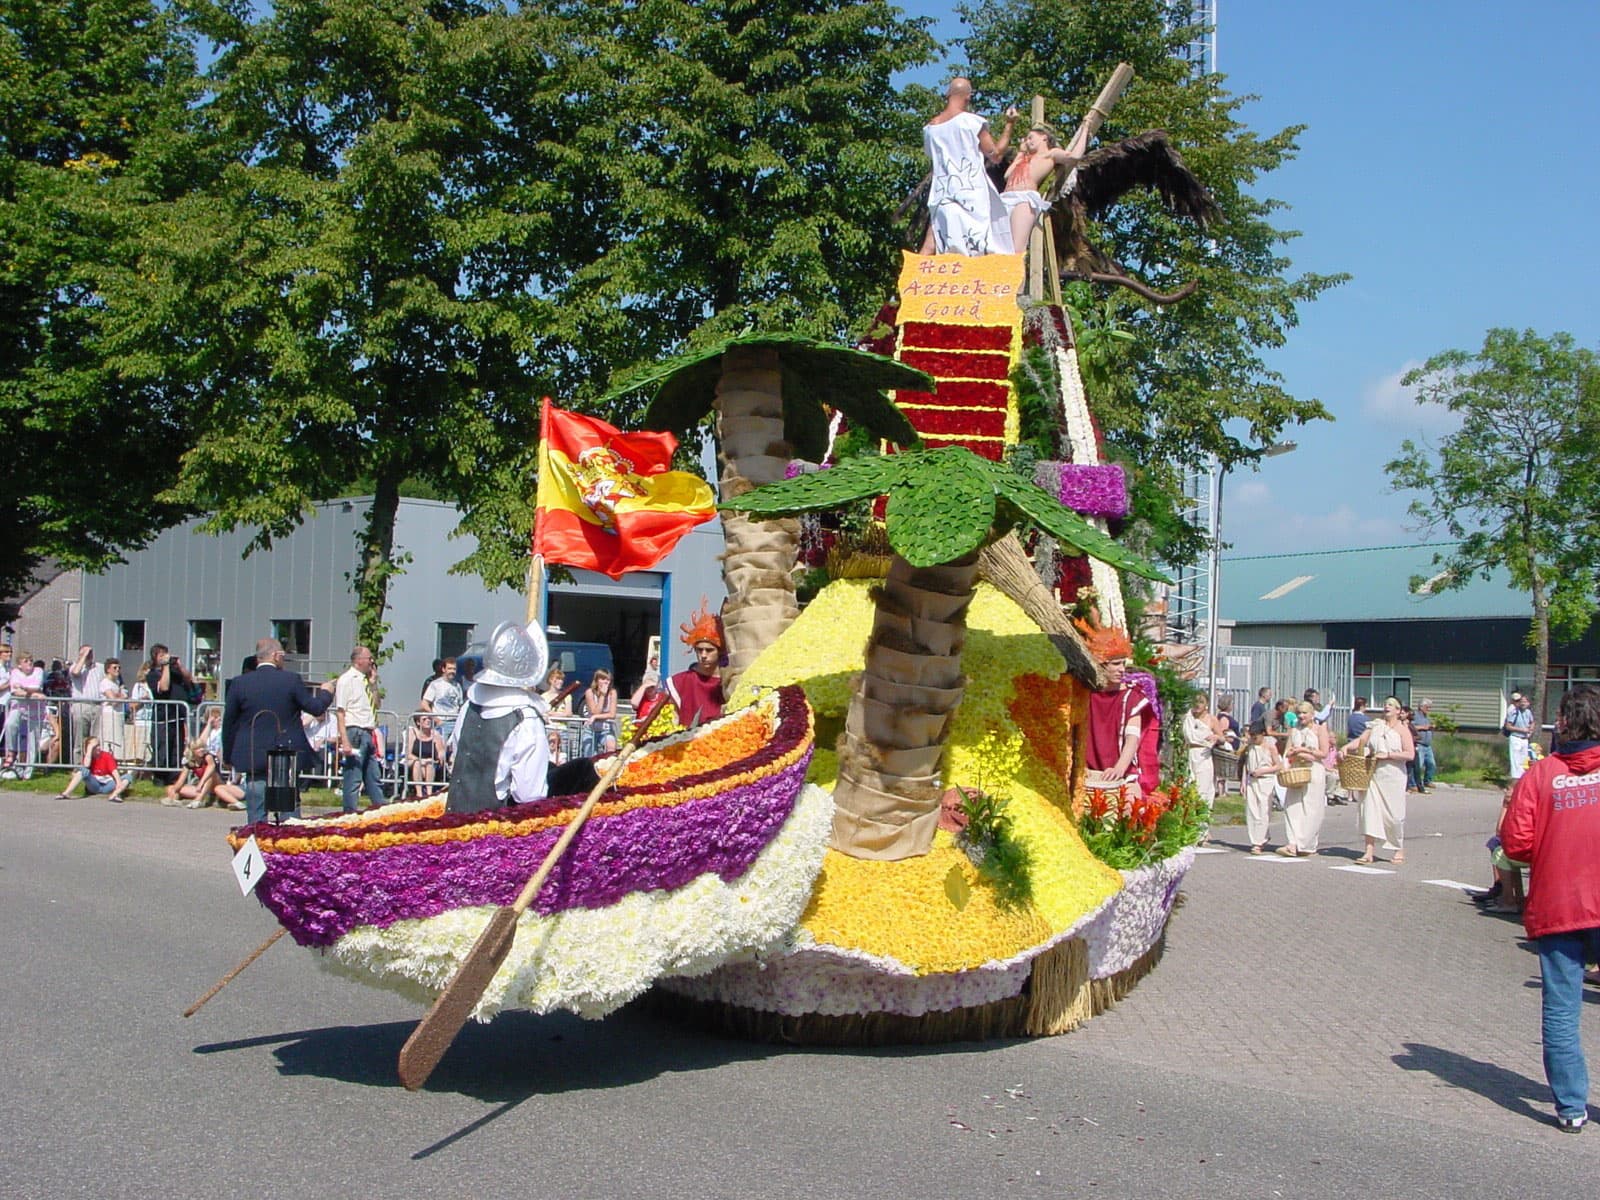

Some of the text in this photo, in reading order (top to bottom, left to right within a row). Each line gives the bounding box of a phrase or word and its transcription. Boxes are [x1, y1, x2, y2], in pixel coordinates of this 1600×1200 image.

[919, 260, 963, 274] Het
[924, 300, 983, 320] Goud
[243, 853, 252, 880] 4
